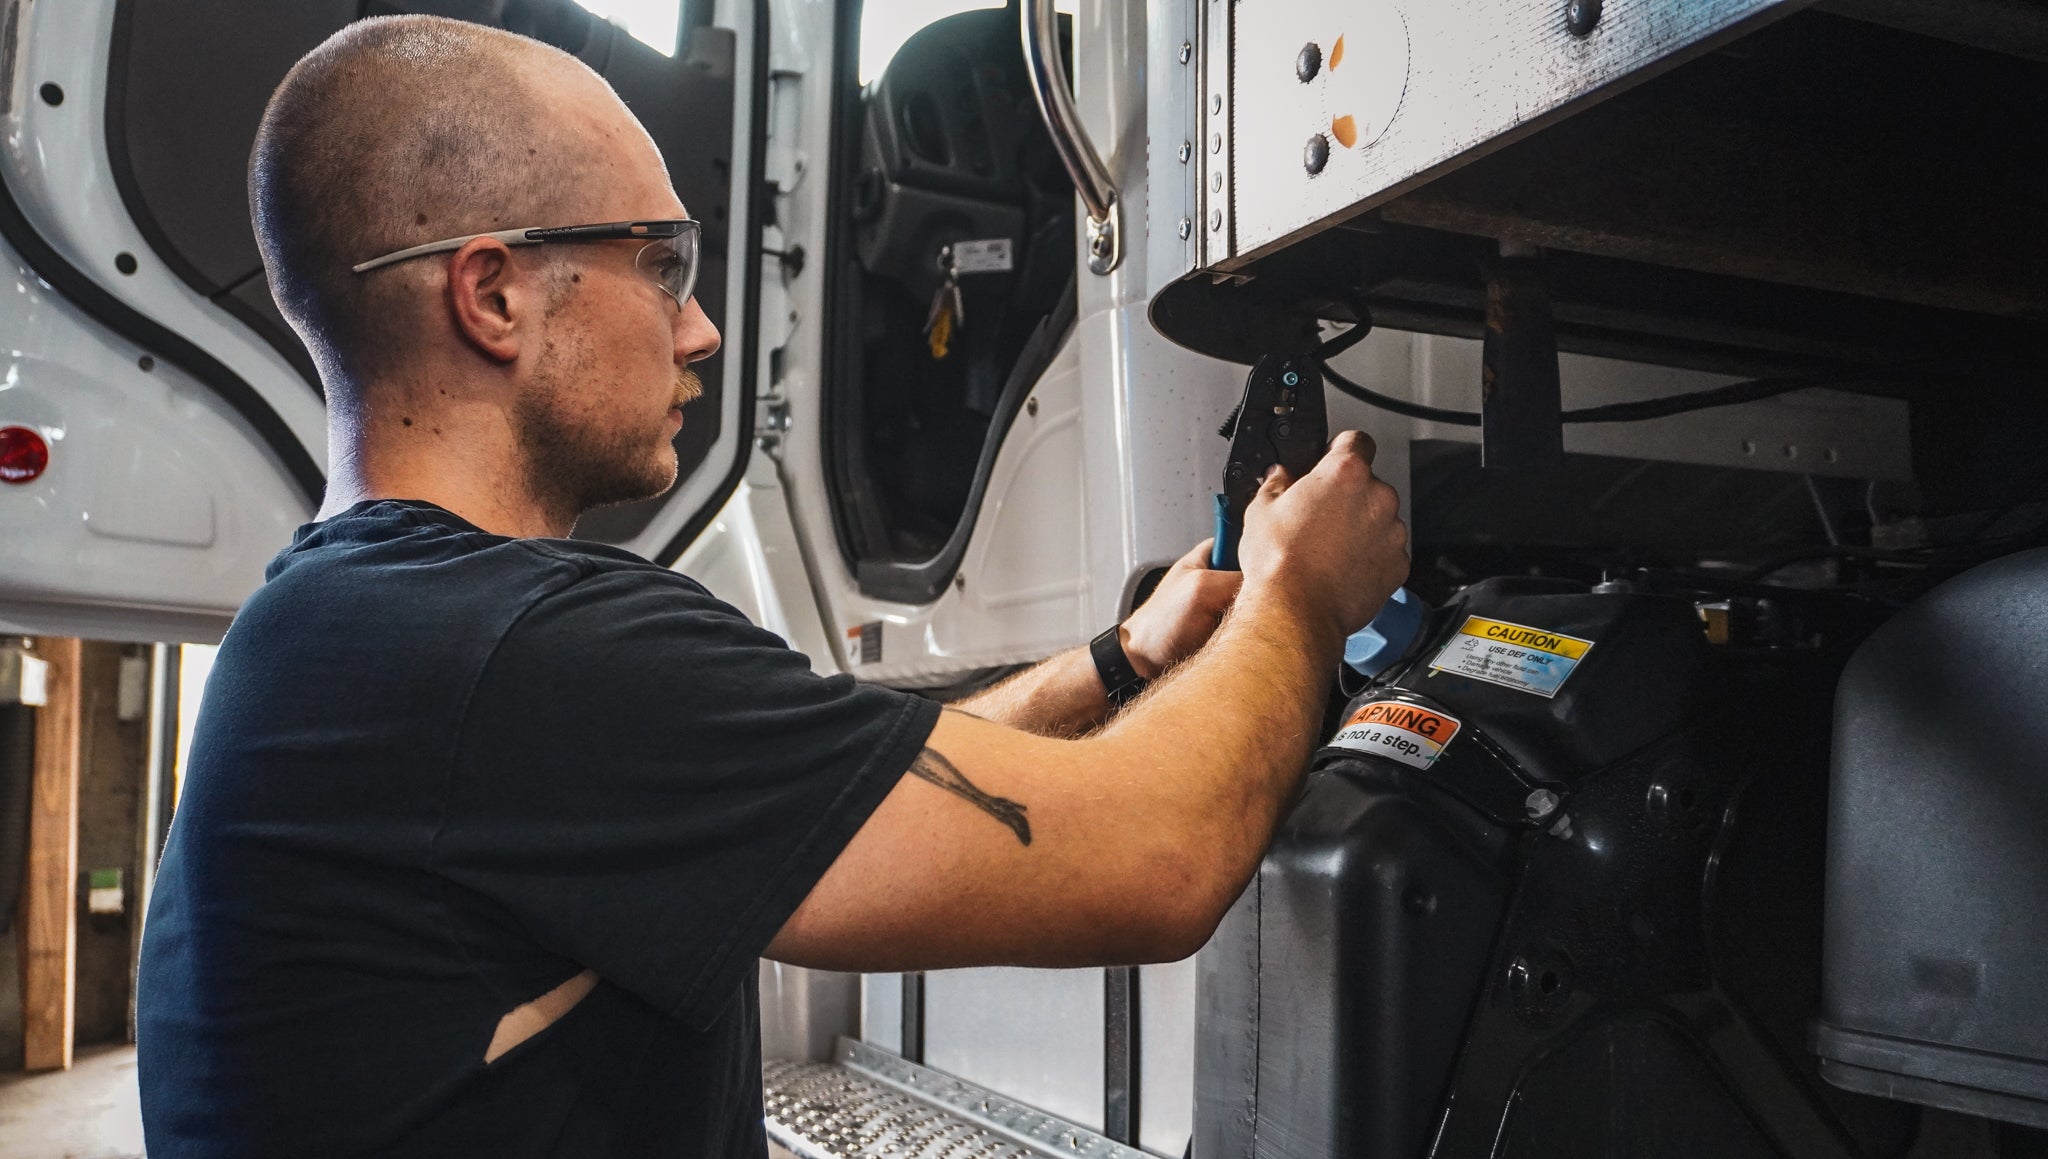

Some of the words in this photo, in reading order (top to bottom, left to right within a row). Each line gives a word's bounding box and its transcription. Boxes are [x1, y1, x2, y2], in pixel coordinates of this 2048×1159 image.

[1487, 625, 1561, 650] CAUTION
[1466, 654, 1483, 662] Using
[1496, 660, 1513, 668] other
[1488, 645, 1508, 655] USE
[1508, 649, 1527, 659] DEF
[1527, 653, 1552, 665] ONLY
[1466, 659, 1491, 670] Dame
[1492, 666, 1513, 676] vehicle
[1488, 671, 1500, 679] fuel
[1347, 729, 1370, 740] not
[1370, 732, 1381, 742] a
[1382, 735, 1421, 757] step.
